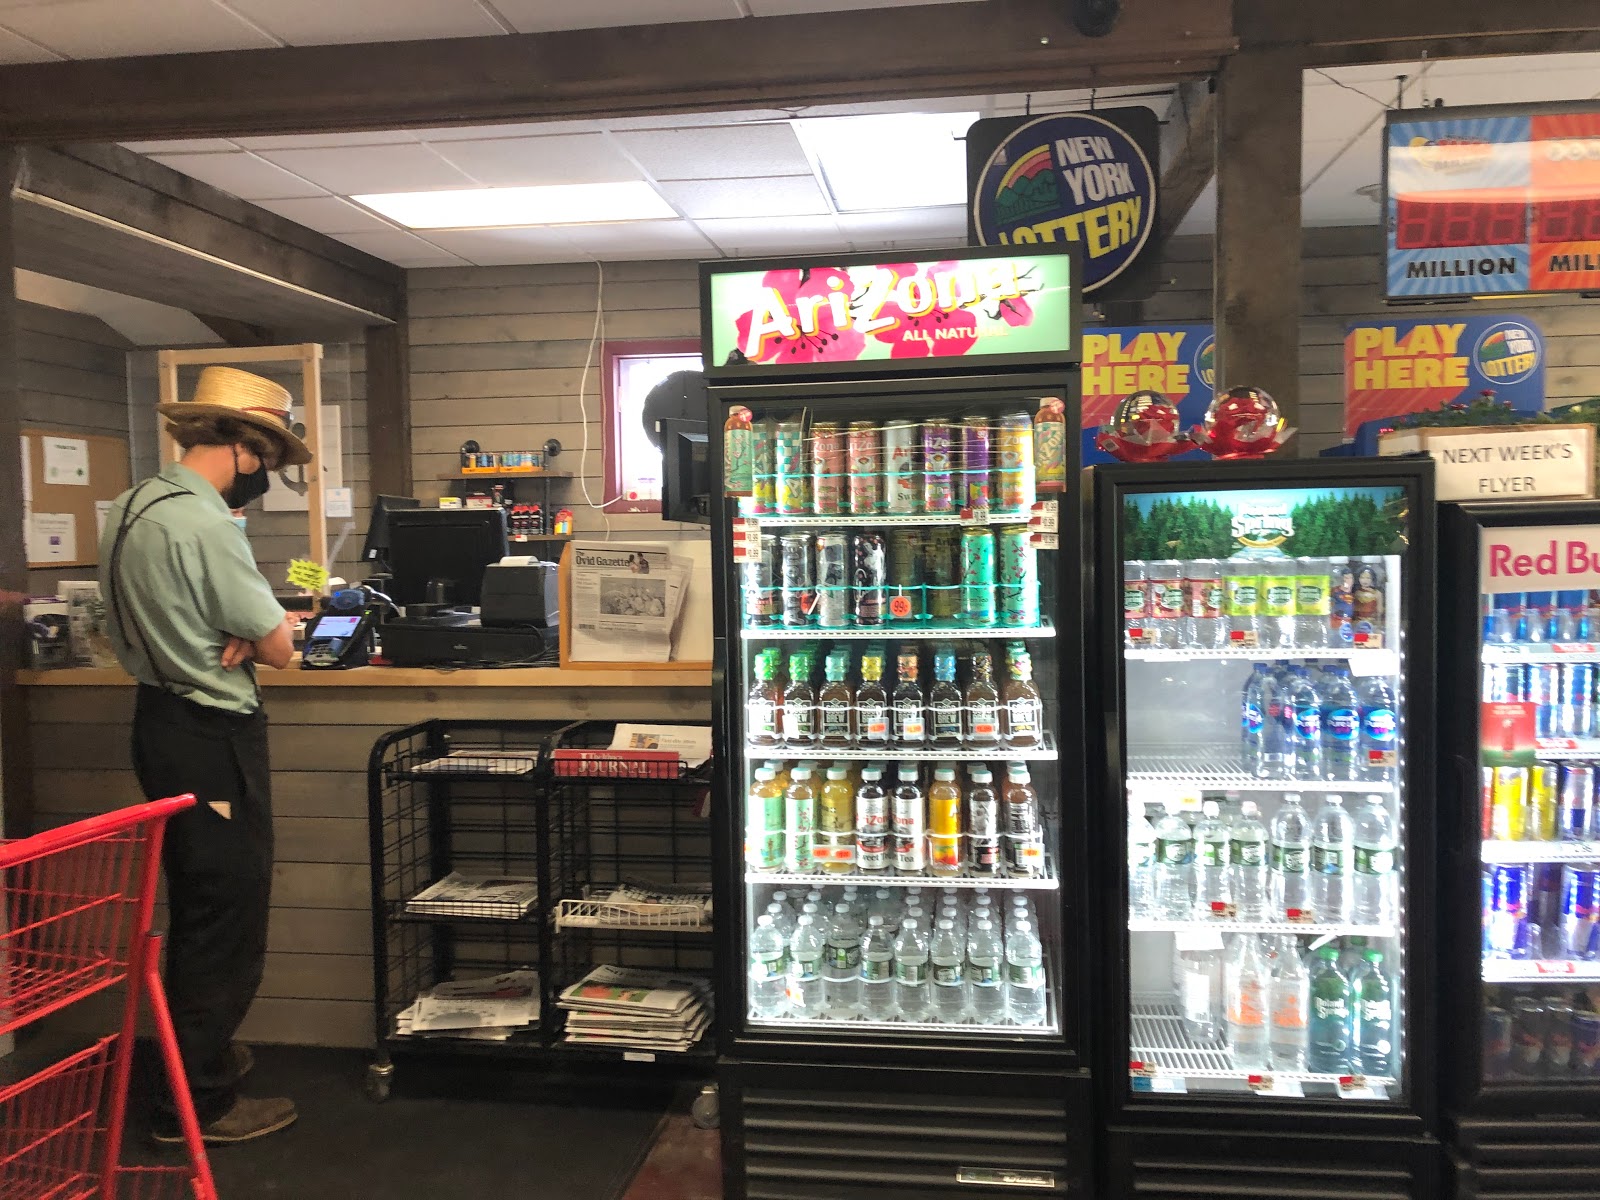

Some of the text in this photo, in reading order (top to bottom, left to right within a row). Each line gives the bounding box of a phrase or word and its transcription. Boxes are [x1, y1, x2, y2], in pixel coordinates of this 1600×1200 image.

[1055, 136, 1115, 167] NEW
[1063, 162, 1136, 206] YORK
[1407, 257, 1516, 279] MILLION
[1549, 253, 1600, 272] MIL
[744, 262, 1021, 360] AriZona
[902, 330, 932, 341] ALL
[1082, 332, 1187, 364] PLAY
[1354, 323, 1467, 357] PLAY
[1082, 364, 1190, 396] HERE
[1353, 356, 1470, 390] HERE
[1443, 443, 1573, 464] NEXT WEEK'S
[1478, 476, 1536, 494] FLYER
[576, 555, 631, 567] Ovid Gazette
[1489, 540, 1558, 577] Red
[579, 752, 652, 774] JOURNAL
